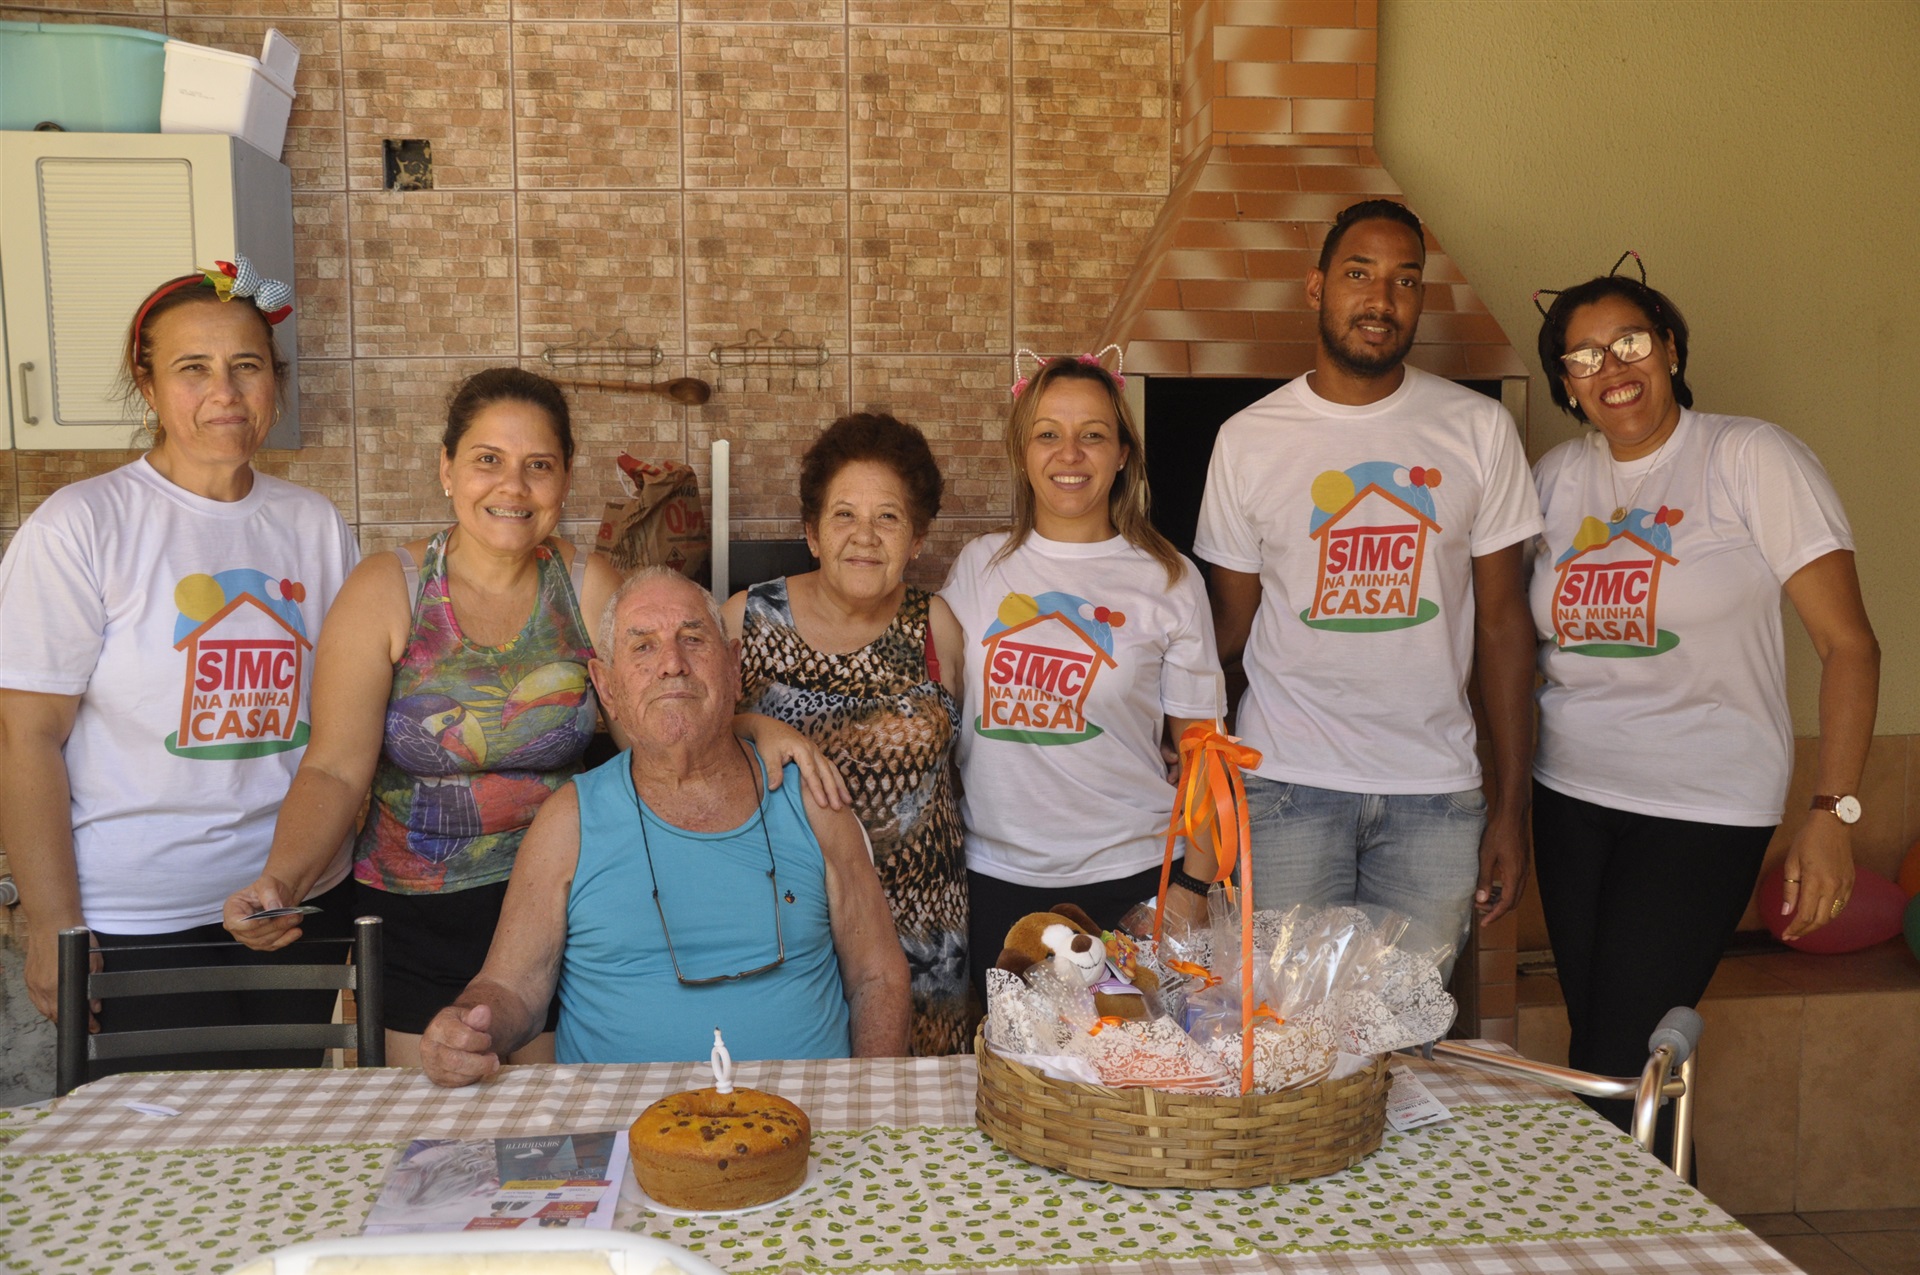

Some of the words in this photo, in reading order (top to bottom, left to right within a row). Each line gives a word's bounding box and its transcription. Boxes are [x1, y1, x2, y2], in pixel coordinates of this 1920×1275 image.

[1326, 524, 1419, 574] STMC
[1324, 575, 1345, 590] NA
[1350, 573, 1410, 587] MINHA
[1559, 560, 1653, 606] STMC
[1320, 588, 1406, 615] CASA
[1558, 608, 1581, 620] NA
[1586, 606, 1645, 620] MINHA
[1562, 620, 1645, 643] CASA
[195, 639, 295, 692] STMC
[990, 640, 1094, 697] STMC
[193, 693, 222, 710] NA
[229, 692, 289, 708] MINHA
[989, 686, 1013, 700] NA
[191, 709, 280, 741] CASA
[991, 700, 1074, 729] CASA
